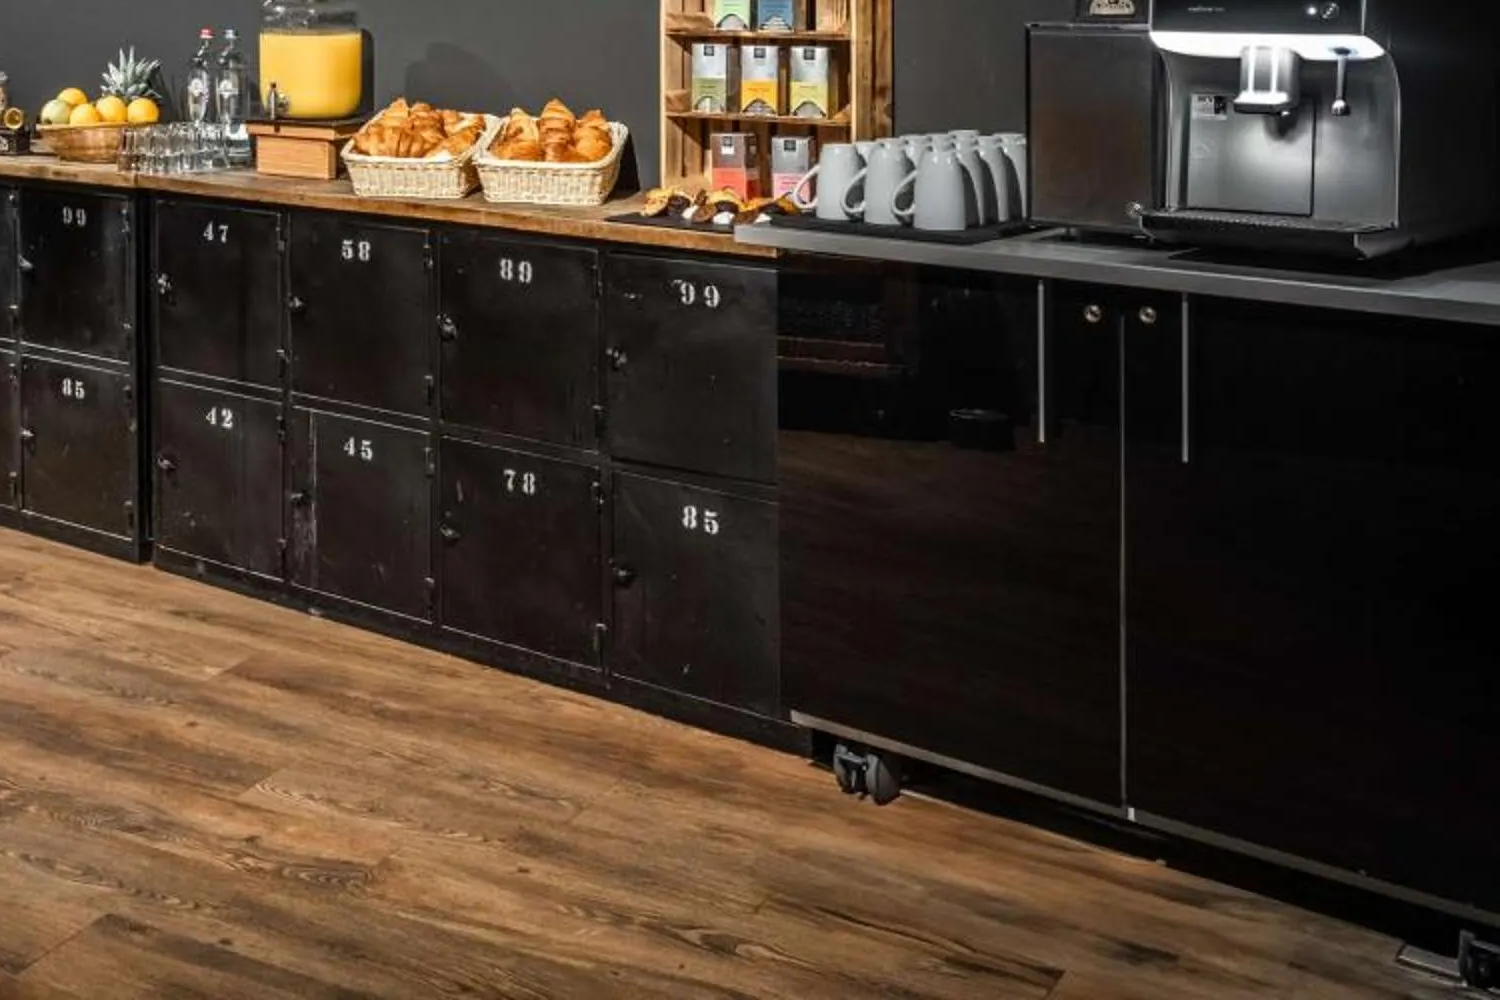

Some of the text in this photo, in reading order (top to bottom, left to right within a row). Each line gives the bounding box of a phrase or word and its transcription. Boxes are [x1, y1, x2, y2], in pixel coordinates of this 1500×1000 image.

[62, 206, 87, 227] 99
[203, 221, 229, 244] 47
[341, 239, 371, 261] 58
[499, 258, 533, 284] 89
[677, 280, 721, 309] 99
[62, 378, 85, 399] 85
[205, 407, 234, 429] 42
[343, 437, 373, 461] 45
[503, 468, 536, 495] 78
[682, 505, 719, 535] 85
